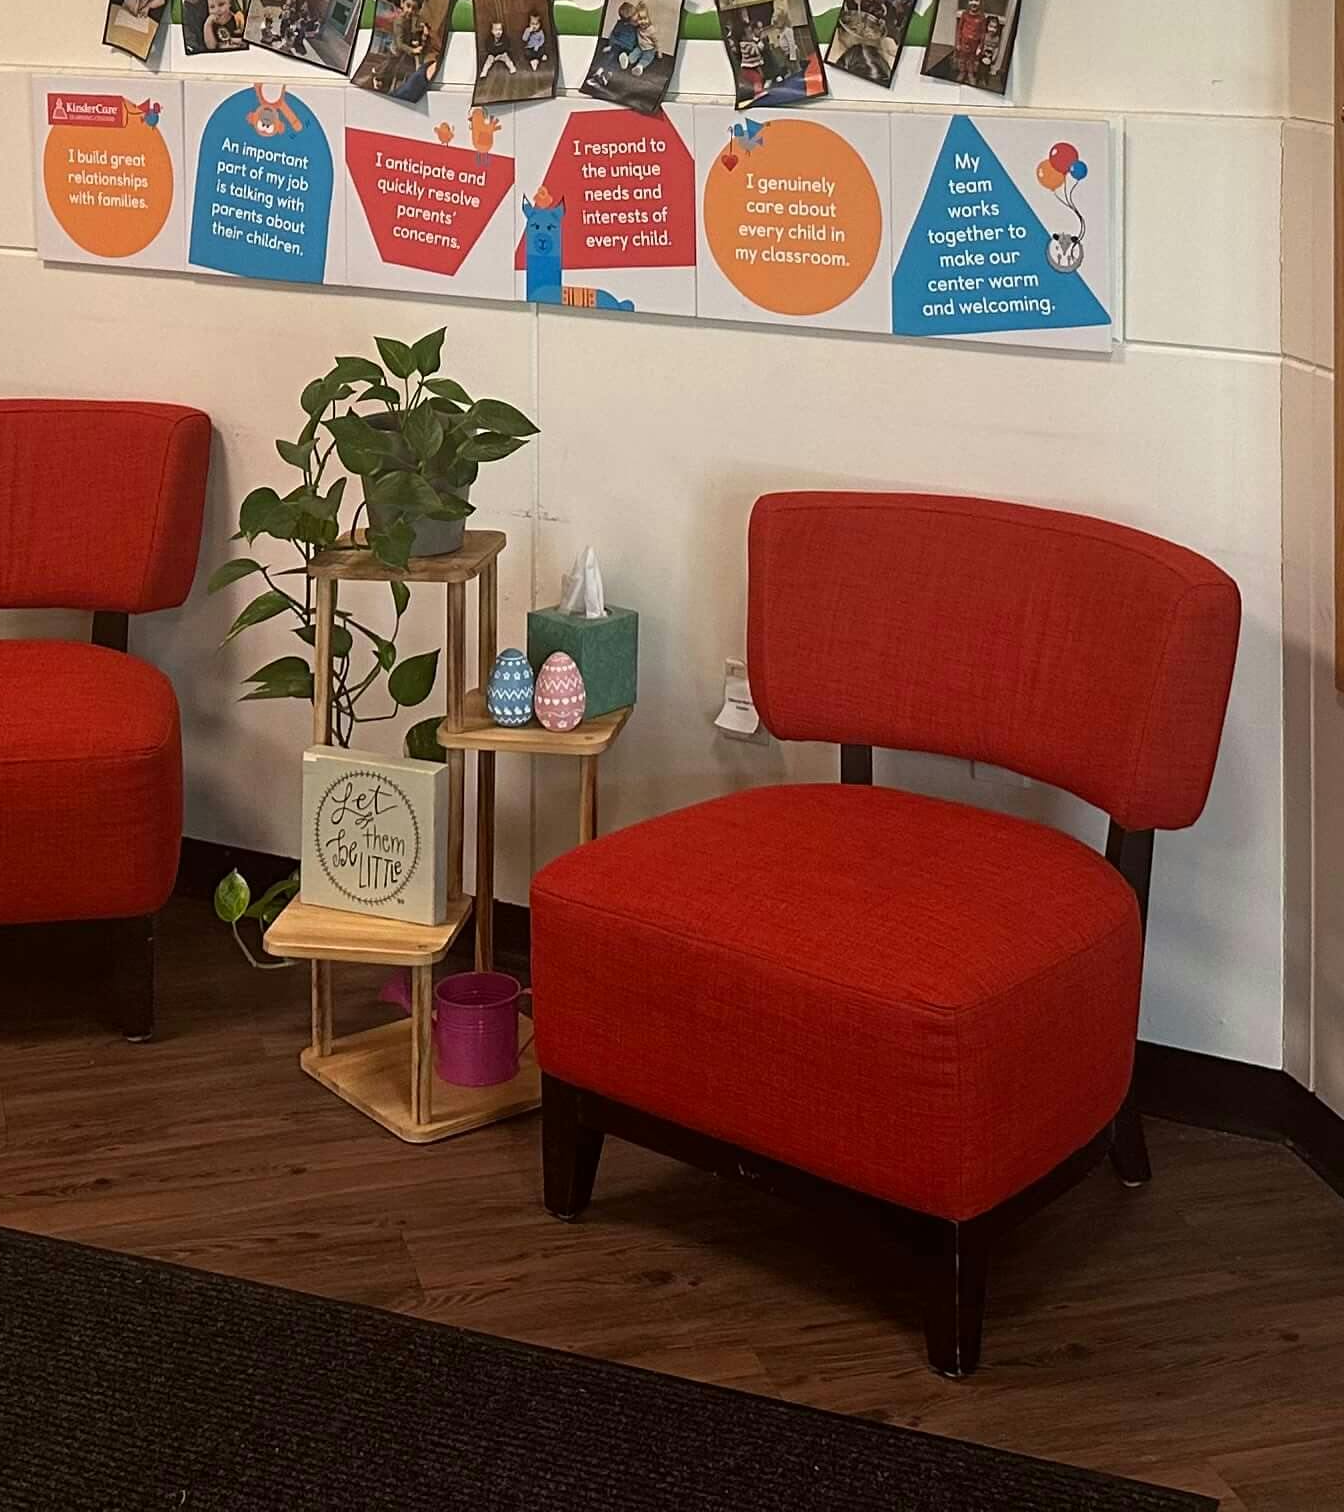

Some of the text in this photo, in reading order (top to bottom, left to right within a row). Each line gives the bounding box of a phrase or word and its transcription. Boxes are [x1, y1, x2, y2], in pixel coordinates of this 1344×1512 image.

[66, 102, 119, 115] KinderCare
[221, 137, 309, 170] An important
[573, 138, 666, 158] I respond to
[68, 149, 146, 168] I build great
[954, 154, 980, 173] My
[68, 170, 149, 189] relationships
[217, 160, 309, 192] part of my job
[375, 152, 486, 187] I anticipate and
[582, 162, 661, 182] the unique
[377, 177, 480, 208] quickly resolve
[584, 185, 663, 201] needs and
[746, 173, 836, 196] I genuinely
[948, 178, 992, 194] team
[69, 191, 149, 209] with families.
[216, 178, 305, 213] is talking with
[212, 201, 305, 235] parents about
[582, 207, 668, 225] interests of
[746, 201, 837, 218] care about
[947, 200, 1000, 218] works
[212, 220, 304, 256] their children.
[392, 225, 461, 250] concerns.
[585, 230, 672, 251] every child.
[738, 224, 845, 243] every child in
[927, 224, 1027, 248] together to
[735, 248, 851, 268] my classroom.
[939, 249, 1020, 268] make our
[927, 274, 1039, 293] center warm
[922, 295, 1056, 317] and welcoming.
[331, 782, 399, 824] Let
[326, 829, 357, 867] be
[363, 824, 405, 856] them
